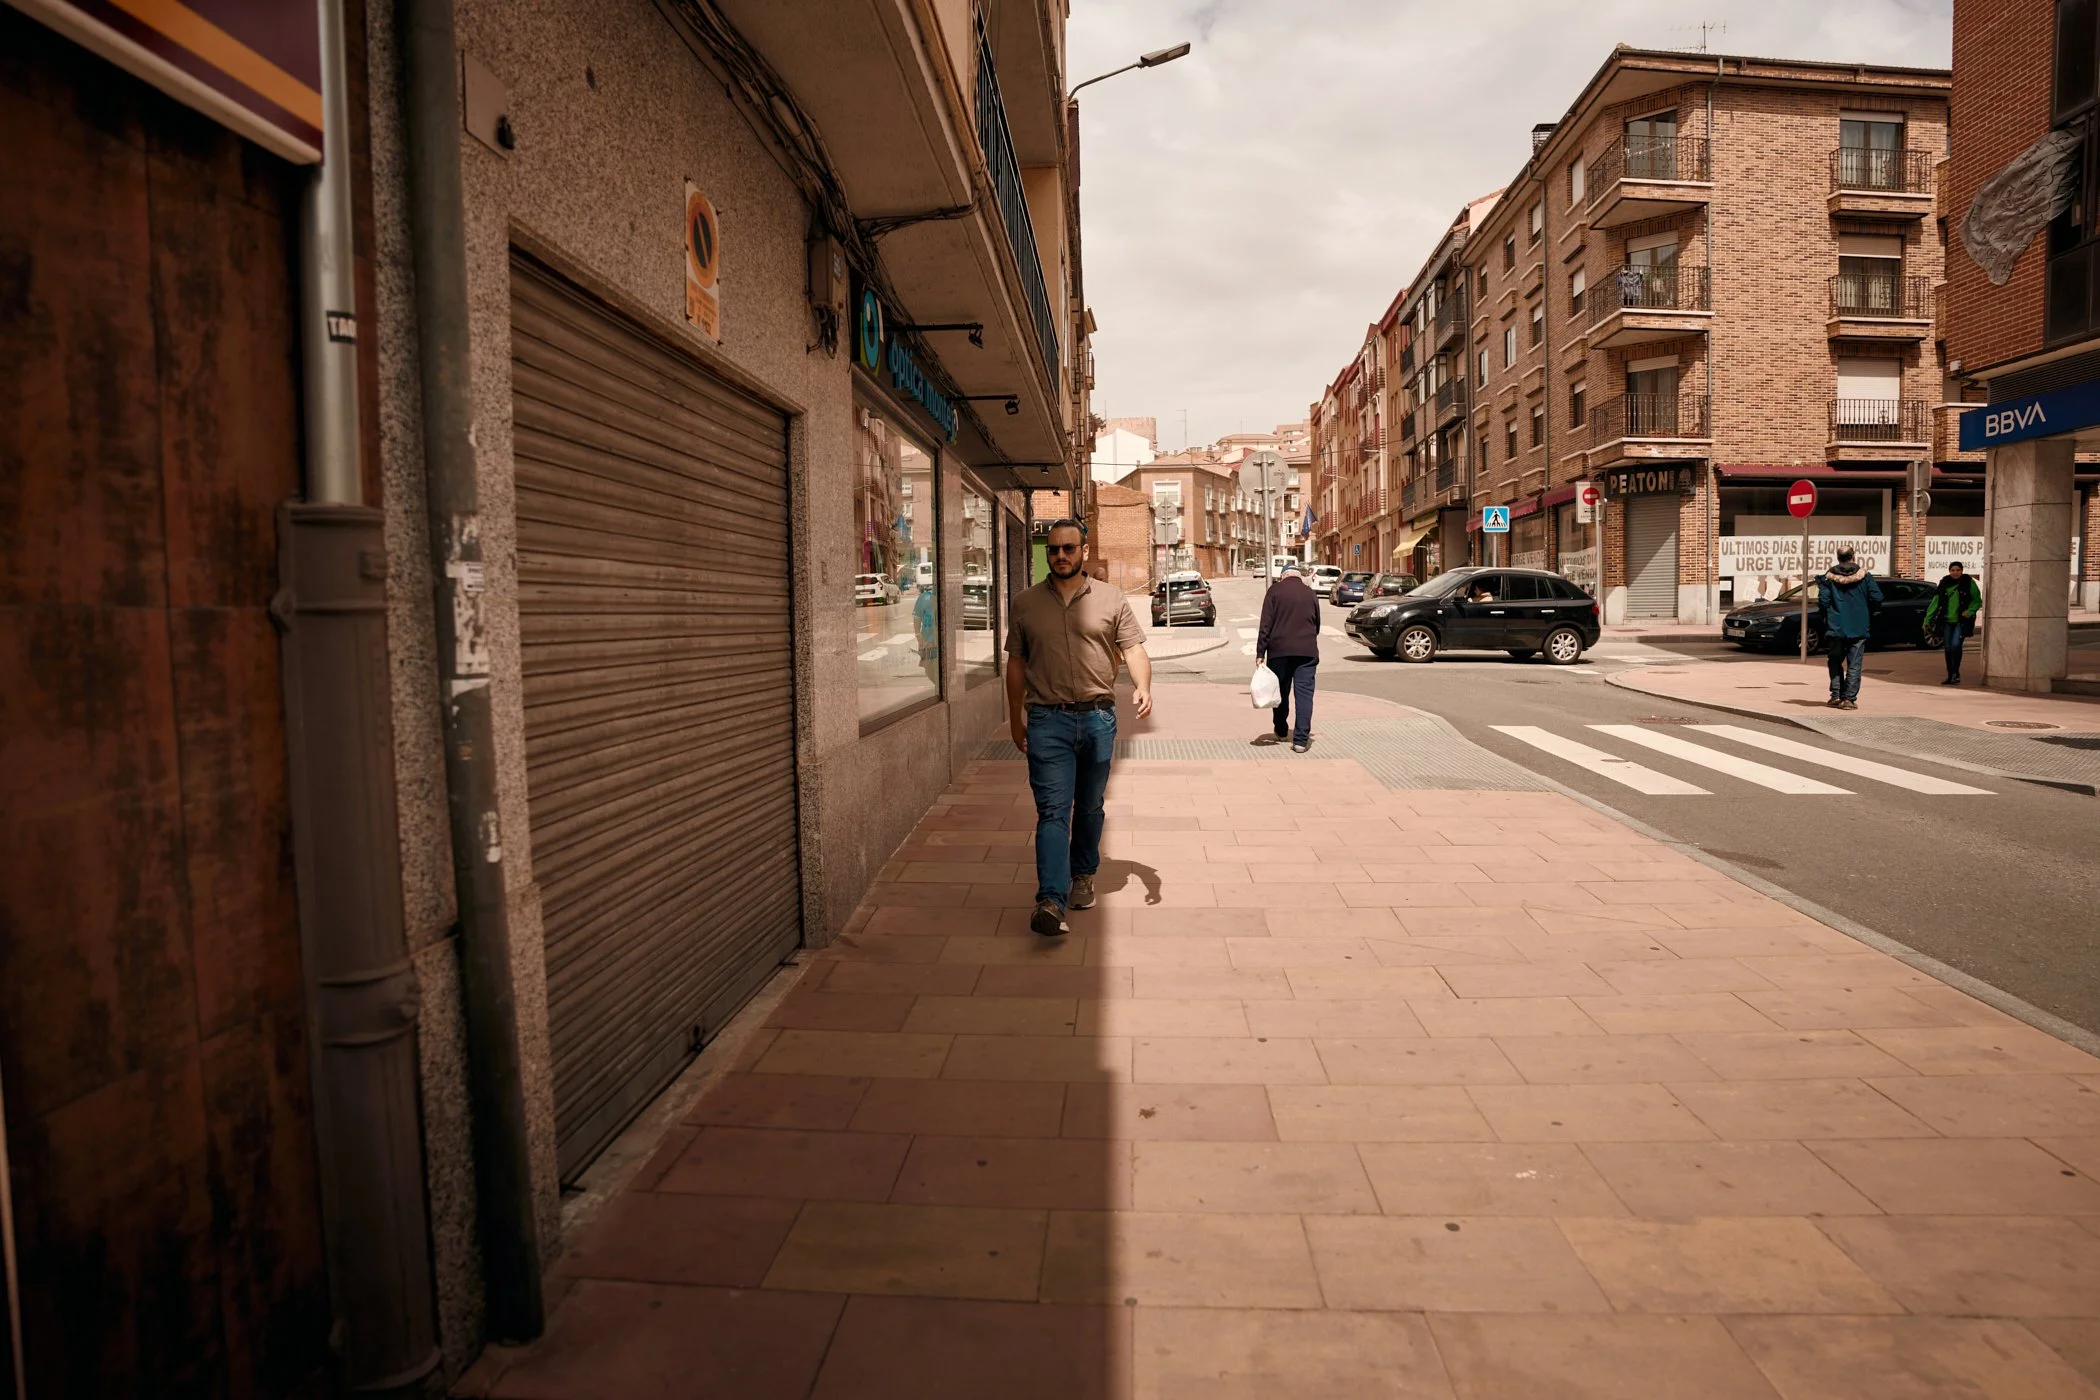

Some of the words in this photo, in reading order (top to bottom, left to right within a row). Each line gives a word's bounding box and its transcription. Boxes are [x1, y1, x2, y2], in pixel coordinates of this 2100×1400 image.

[1986, 401, 2046, 437] BBVA
[1721, 537, 1769, 556] ÚLTIMOS
[1772, 537, 1798, 555] DÍAS
[1928, 537, 1974, 555] ÚLTIMOS
[1736, 556, 1773, 572] URGE
[1778, 556, 1833, 571] VENDER
